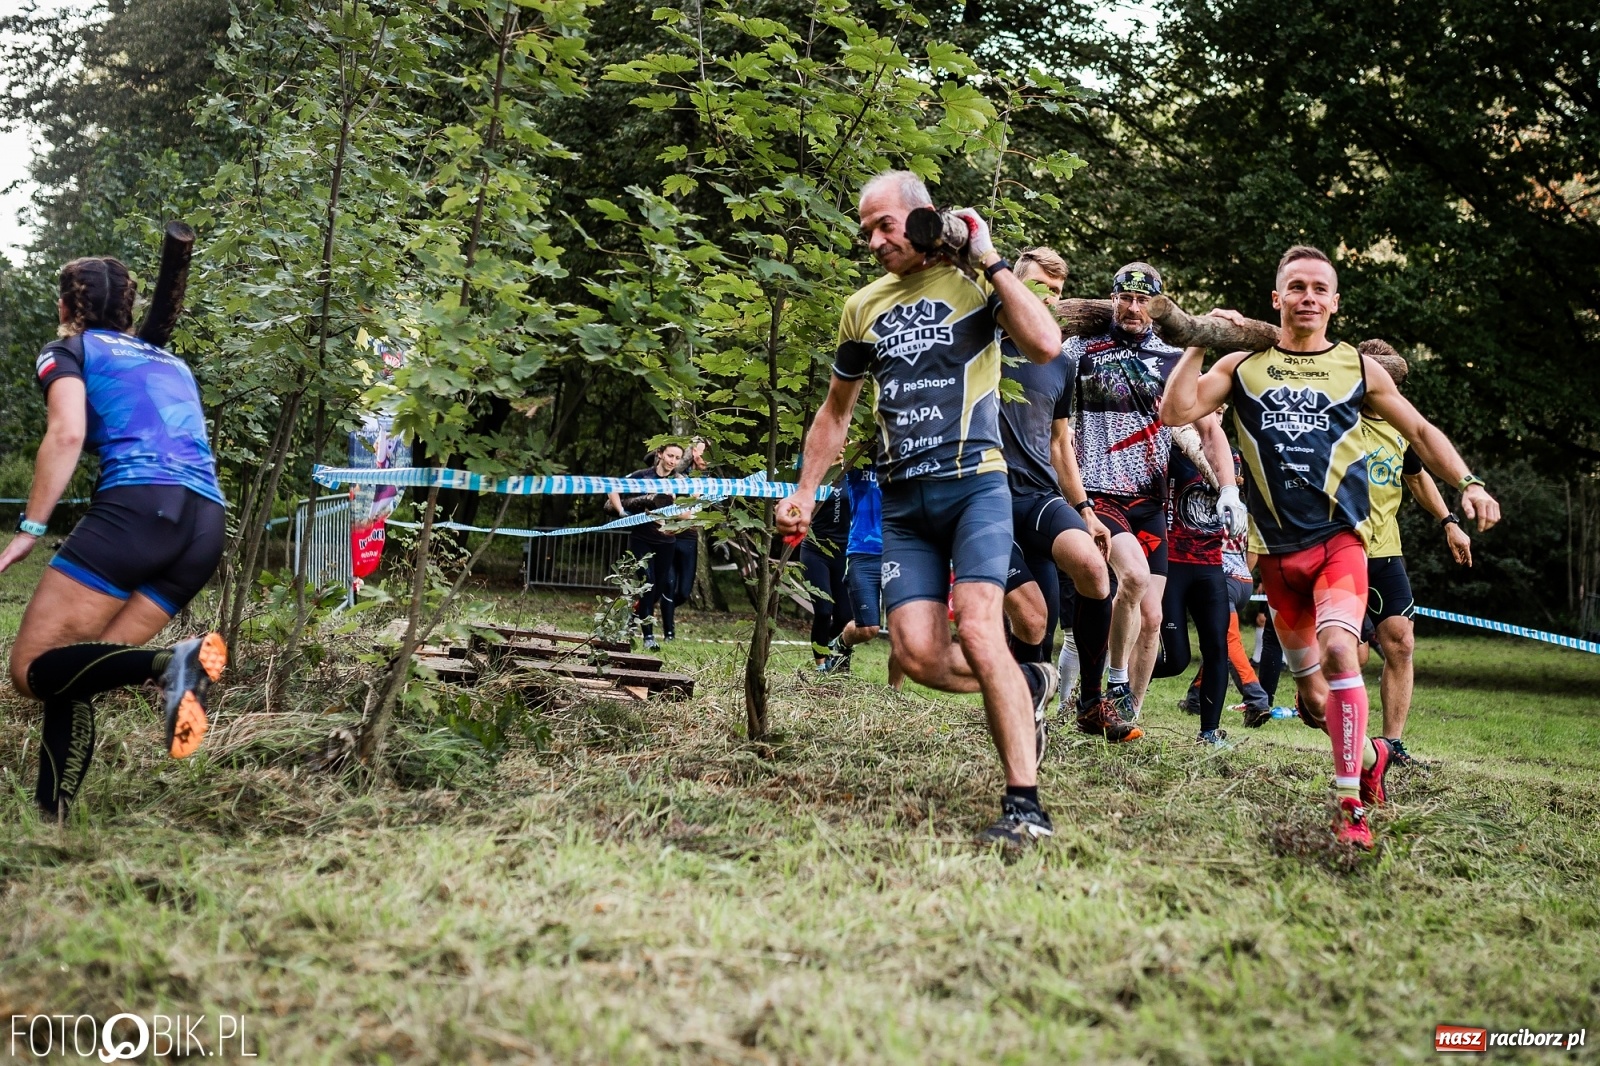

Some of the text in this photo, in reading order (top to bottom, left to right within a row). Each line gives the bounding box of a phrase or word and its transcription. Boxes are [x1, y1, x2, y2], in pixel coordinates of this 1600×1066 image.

[876, 326, 952, 356] SOCIOS
[893, 342, 927, 355] SILESIA
[903, 377, 956, 393] ReShape
[1263, 412, 1328, 429] SOCIOS
[1285, 446, 1315, 454] ReShape
[60, 700, 92, 796] RUNMAGEDDON
